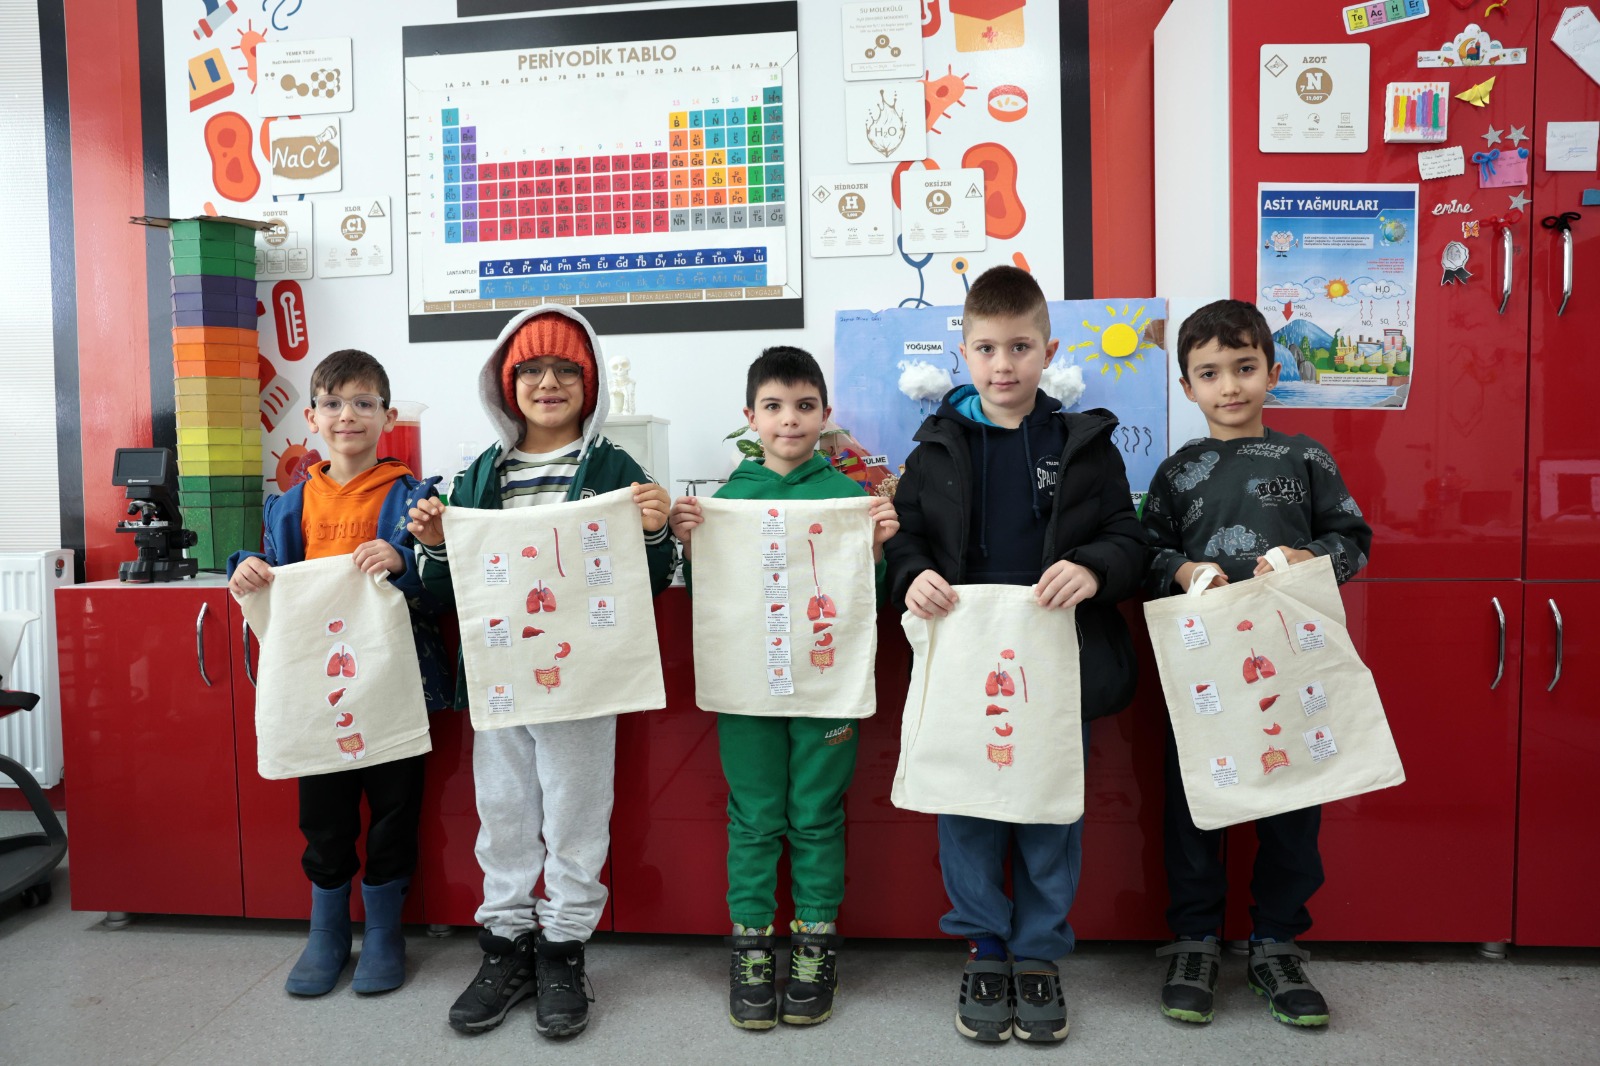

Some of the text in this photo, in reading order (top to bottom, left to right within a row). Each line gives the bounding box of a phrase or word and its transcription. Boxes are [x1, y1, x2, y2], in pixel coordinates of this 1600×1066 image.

[518, 45, 677, 70] PERİYODİK TABLO
[1306, 72, 1323, 90] N
[673, 139, 682, 147] Al
[752, 135, 760, 143] Cl
[272, 145, 330, 169] NaCl
[691, 158, 704, 166] Ge
[712, 157, 722, 165] As
[712, 176, 722, 184] Sb
[732, 175, 742, 183] Te
[834, 182, 868, 190] HİDROJEN
[925, 180, 951, 188] OKSİJEN
[845, 196, 859, 210] H
[932, 192, 945, 206] O
[1264, 197, 1379, 211] ASİT YAĞMURLARI
[1432, 199, 1473, 215] emine
[346, 218, 362, 232] Cl
[753, 214, 763, 222] Ts
[523, 265, 532, 273] Pr
[540, 263, 552, 271] Nd
[577, 261, 590, 269] Sm
[597, 261, 608, 269] Eu
[616, 259, 628, 267] Gd
[636, 258, 647, 267] Tb
[655, 258, 666, 268] Dy
[674, 257, 686, 265] Ho
[695, 256, 704, 264] Er
[712, 255, 726, 263] Tm
[733, 254, 744, 262] Yb
[754, 253, 764, 262] Lu
[906, 343, 942, 352] YOĞUŞMA
